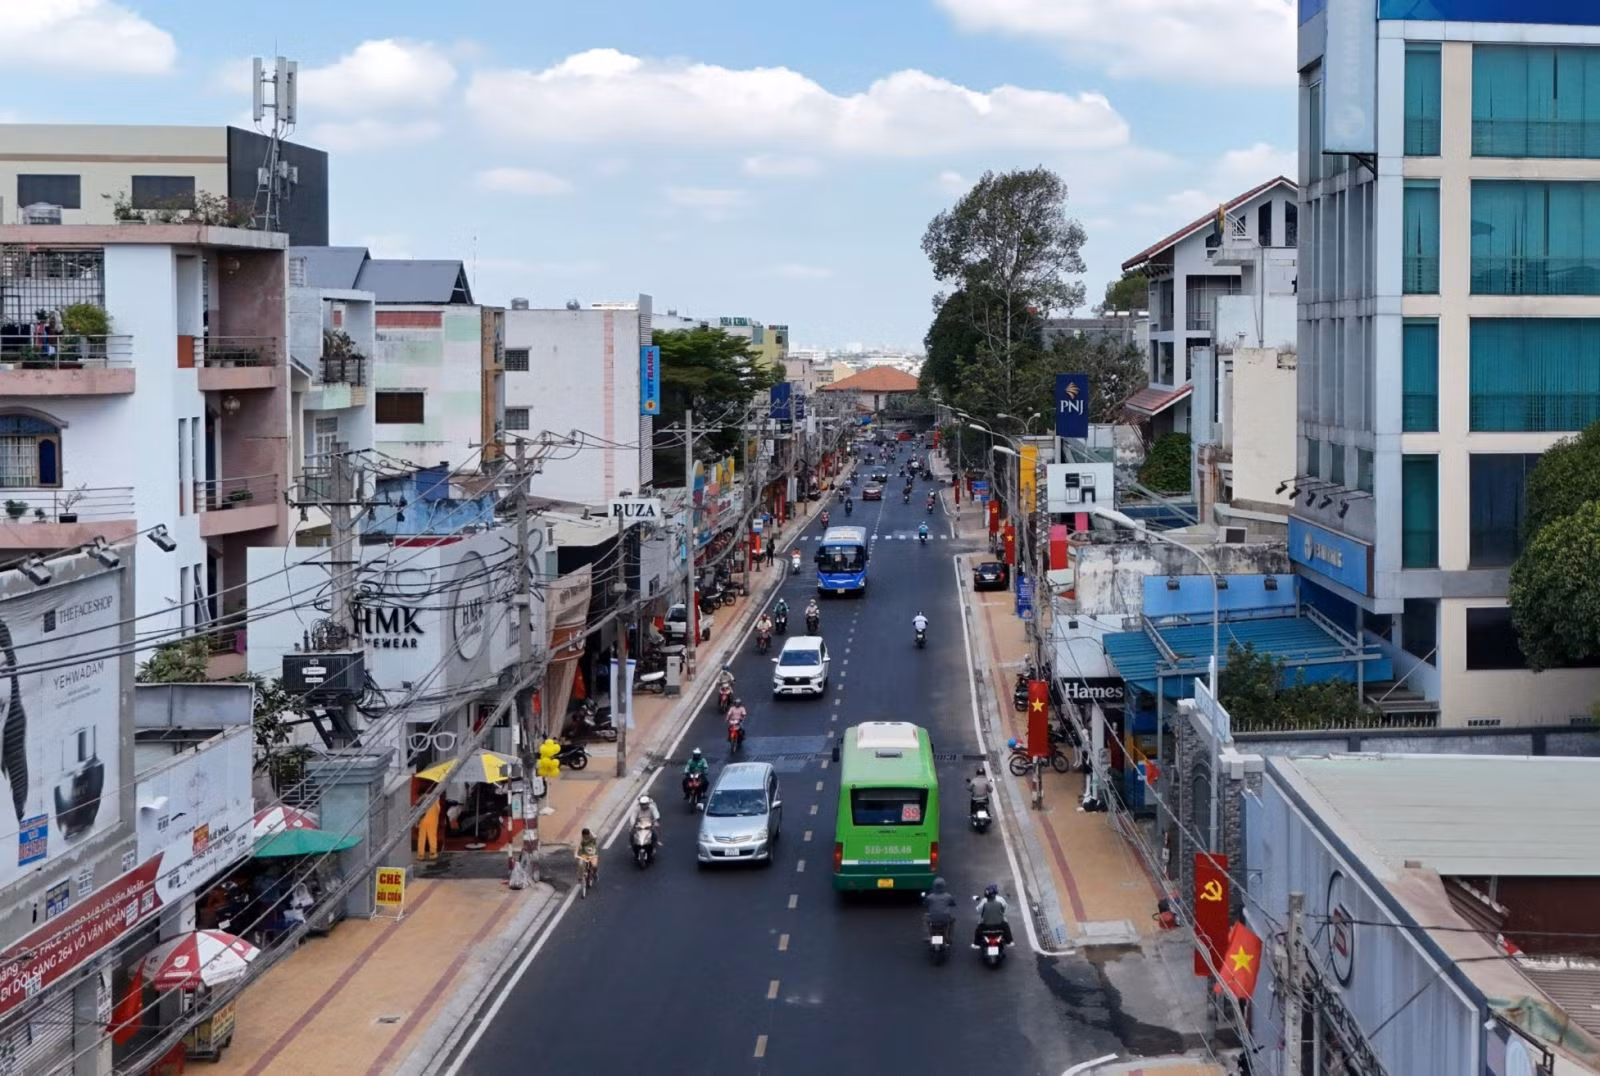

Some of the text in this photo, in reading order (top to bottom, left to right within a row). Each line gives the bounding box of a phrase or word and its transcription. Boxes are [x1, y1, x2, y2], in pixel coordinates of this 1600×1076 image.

[1060, 400, 1084, 415] PNJ
[353, 606, 425, 634] HMK
[53, 660, 104, 690] YEHWADAM
[1064, 682, 1124, 699] Hames
[32, 953, 57, 977] SANG
[57, 944, 73, 964] 264
